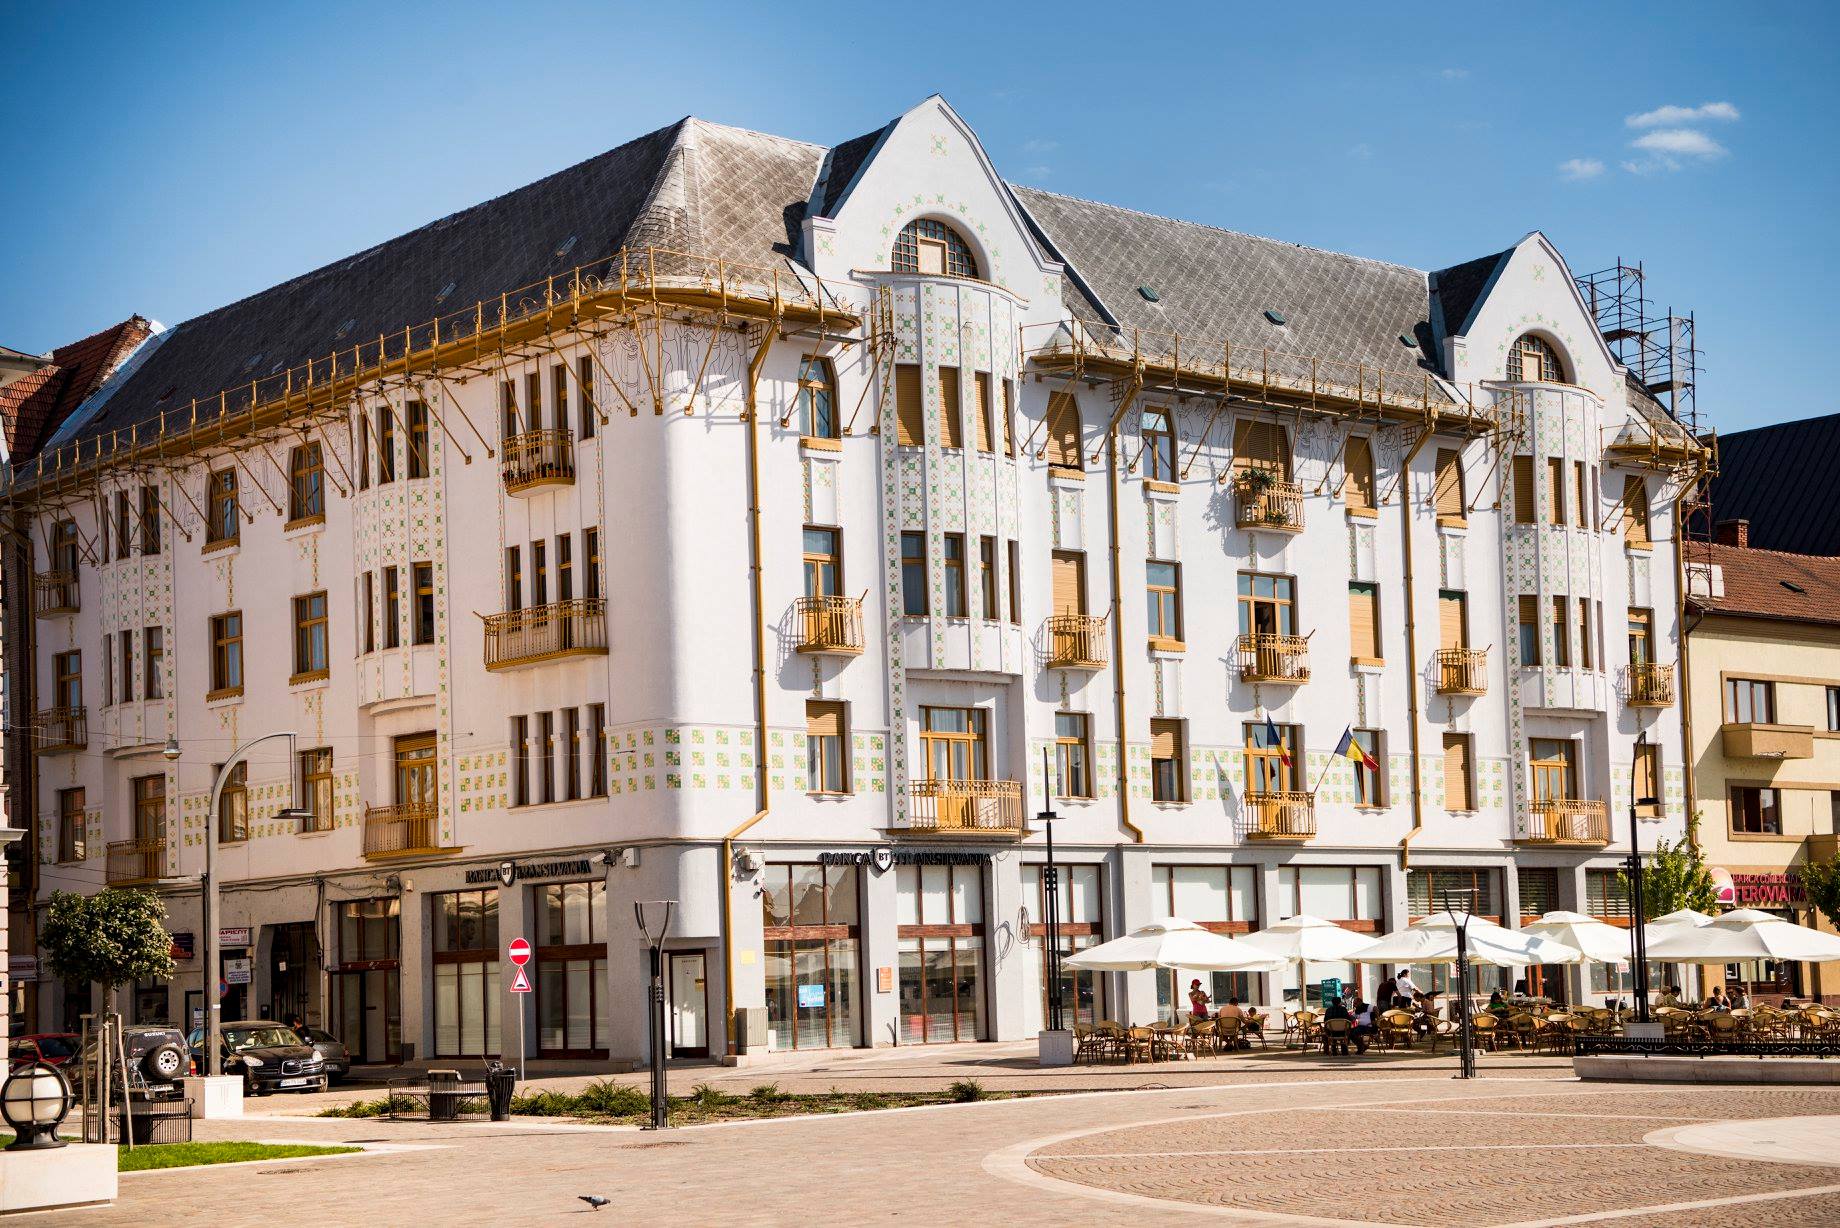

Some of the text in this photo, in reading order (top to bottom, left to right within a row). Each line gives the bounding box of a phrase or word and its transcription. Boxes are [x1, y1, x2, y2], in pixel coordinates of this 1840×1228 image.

[823, 853, 993, 866] BANCA BT TRANSILVANIA
[465, 860, 592, 883] BANCA BT TRANSILVANIA
[1733, 873, 1760, 884] BANCA
[1735, 885, 1807, 903] FEROVIARA
